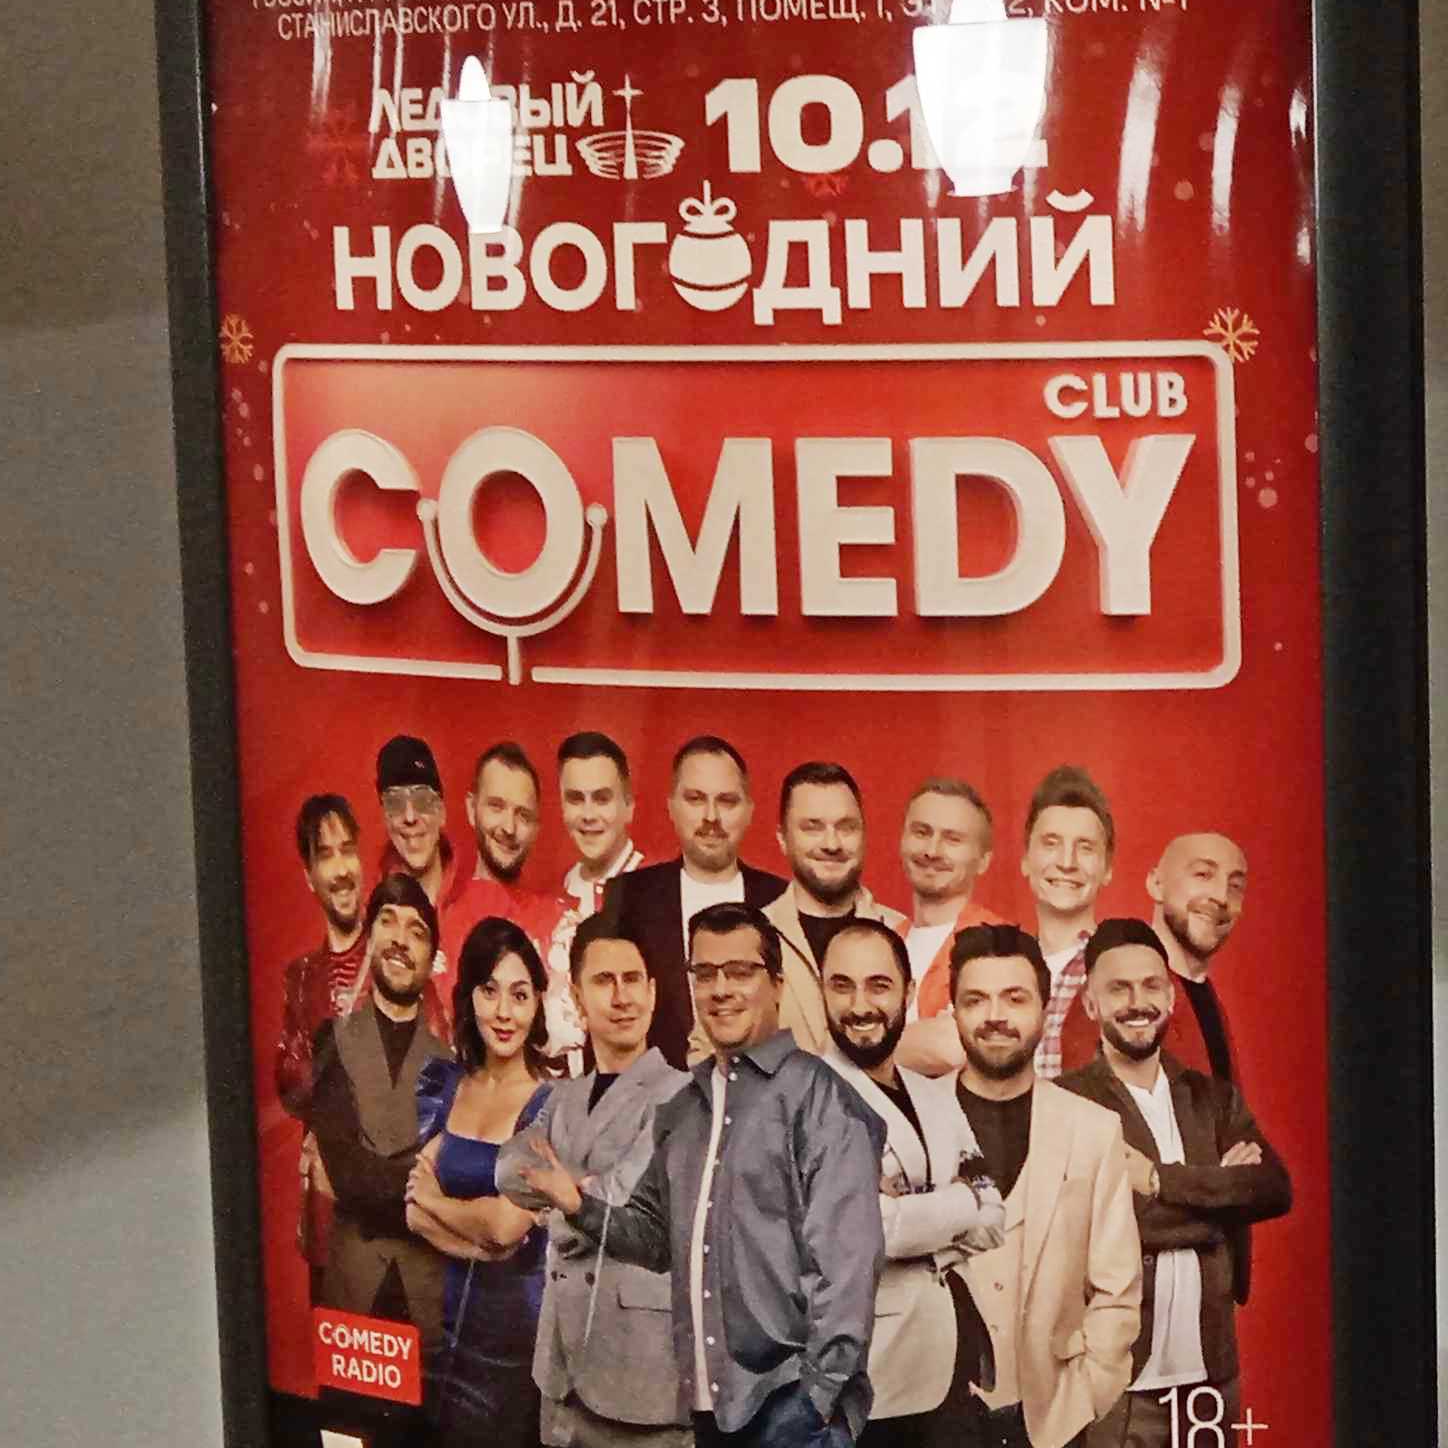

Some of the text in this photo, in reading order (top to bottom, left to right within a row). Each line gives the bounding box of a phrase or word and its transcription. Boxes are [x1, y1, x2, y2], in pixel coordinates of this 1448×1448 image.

[278, 1, 496, 40] СТАНИСЛАВСКОГО
[502, 2, 549, 34] УЛ.,
[555, 2, 583, 33] Д.
[590, 0, 626, 31] 21,
[369, 70, 604, 134] ЛЕДЫЙ
[705, 73, 1048, 174] 10.1
[372, 134, 573, 180] ДВЕЦ
[1042, 371, 1189, 420] CLUB
[299, 425, 1196, 638] COMEDY
[318, 1321, 414, 1361] COMEDY
[331, 1353, 402, 1390] RADIO
